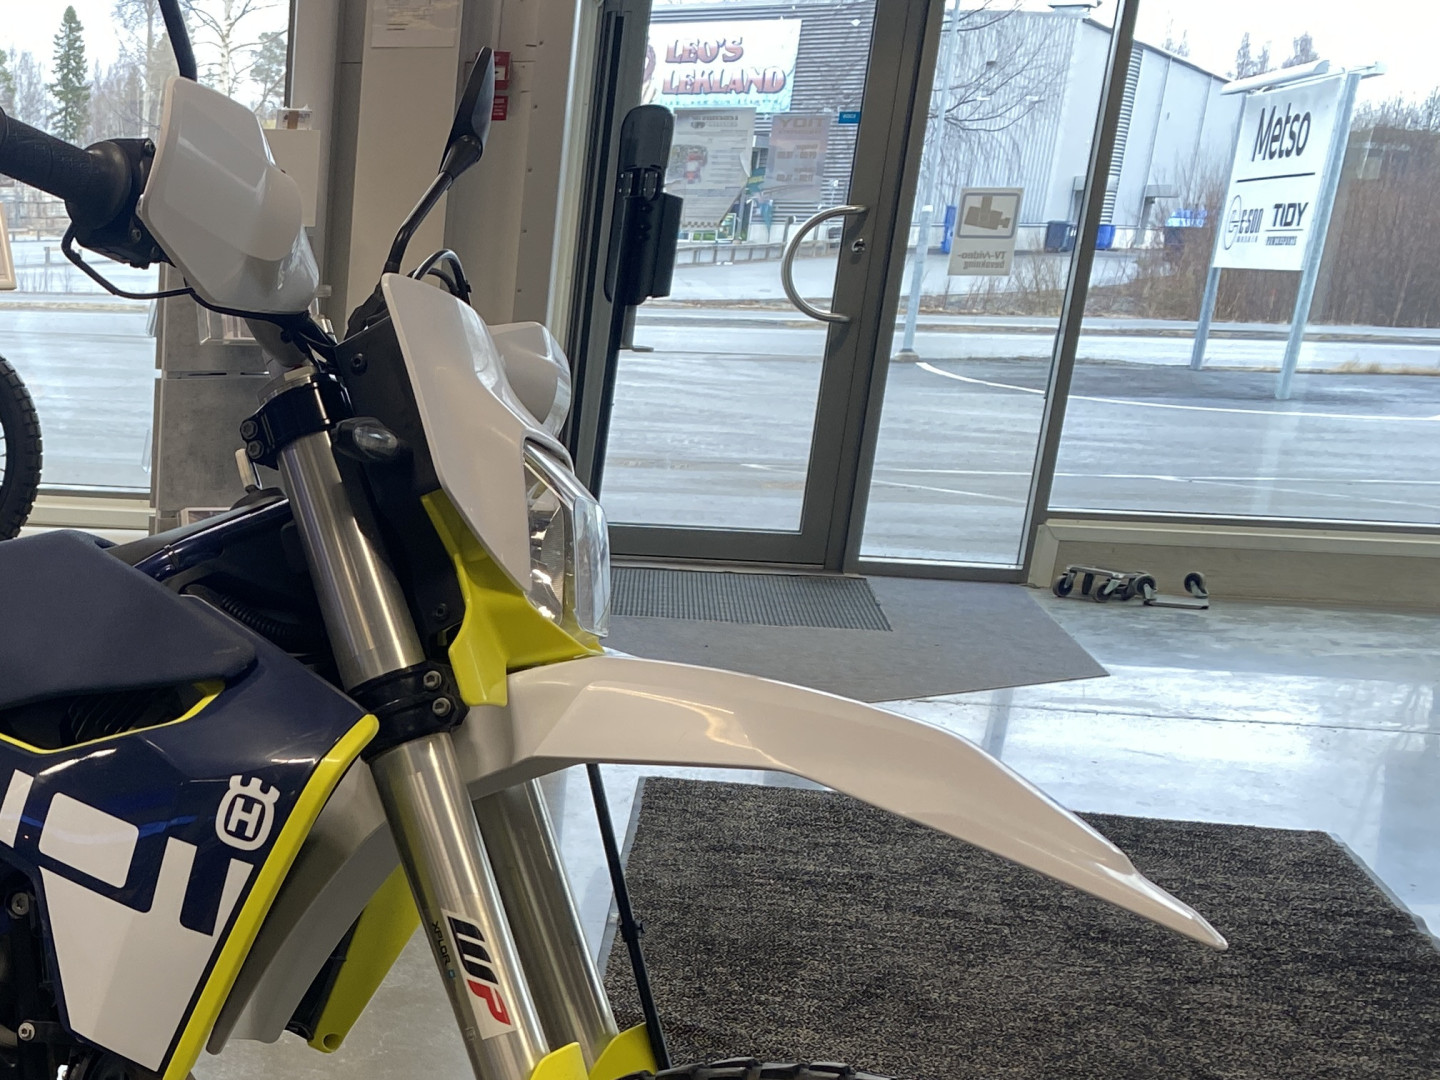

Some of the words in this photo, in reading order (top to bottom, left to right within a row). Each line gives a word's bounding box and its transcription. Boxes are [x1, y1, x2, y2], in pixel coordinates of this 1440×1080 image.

[665, 37, 744, 64] LEO'S
[662, 66, 787, 95] LEKLAND
[1251, 102, 1312, 162] Metso
[1272, 202, 1309, 227] TIDY
[431, 921, 451, 967] XPLOR
